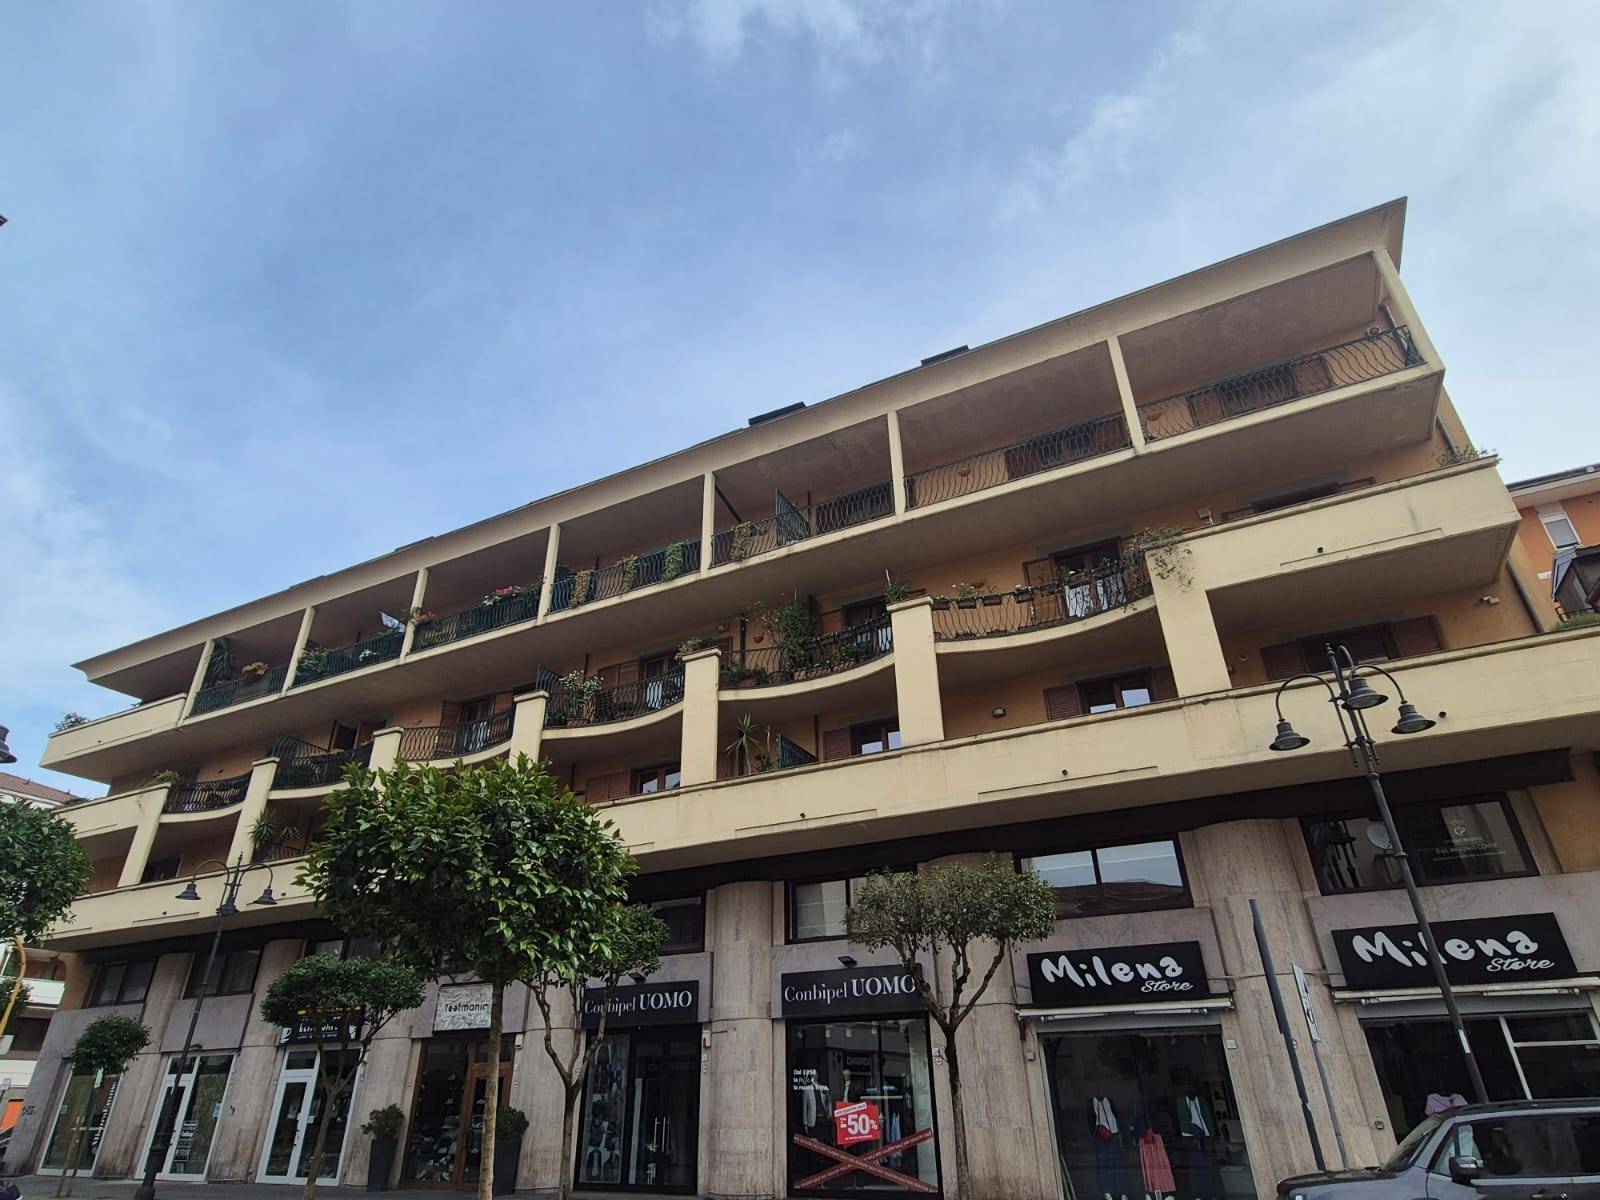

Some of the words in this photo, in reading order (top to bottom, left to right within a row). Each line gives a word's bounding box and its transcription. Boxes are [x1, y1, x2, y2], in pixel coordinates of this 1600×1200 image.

[1041, 955, 1183, 988] Milena
[1486, 957, 1555, 972] Store
[784, 983, 848, 1005] Conbipel
[851, 975, 917, 997] UOMO
[1141, 980, 1194, 993] Store
[640, 990, 692, 1010] UOMO
